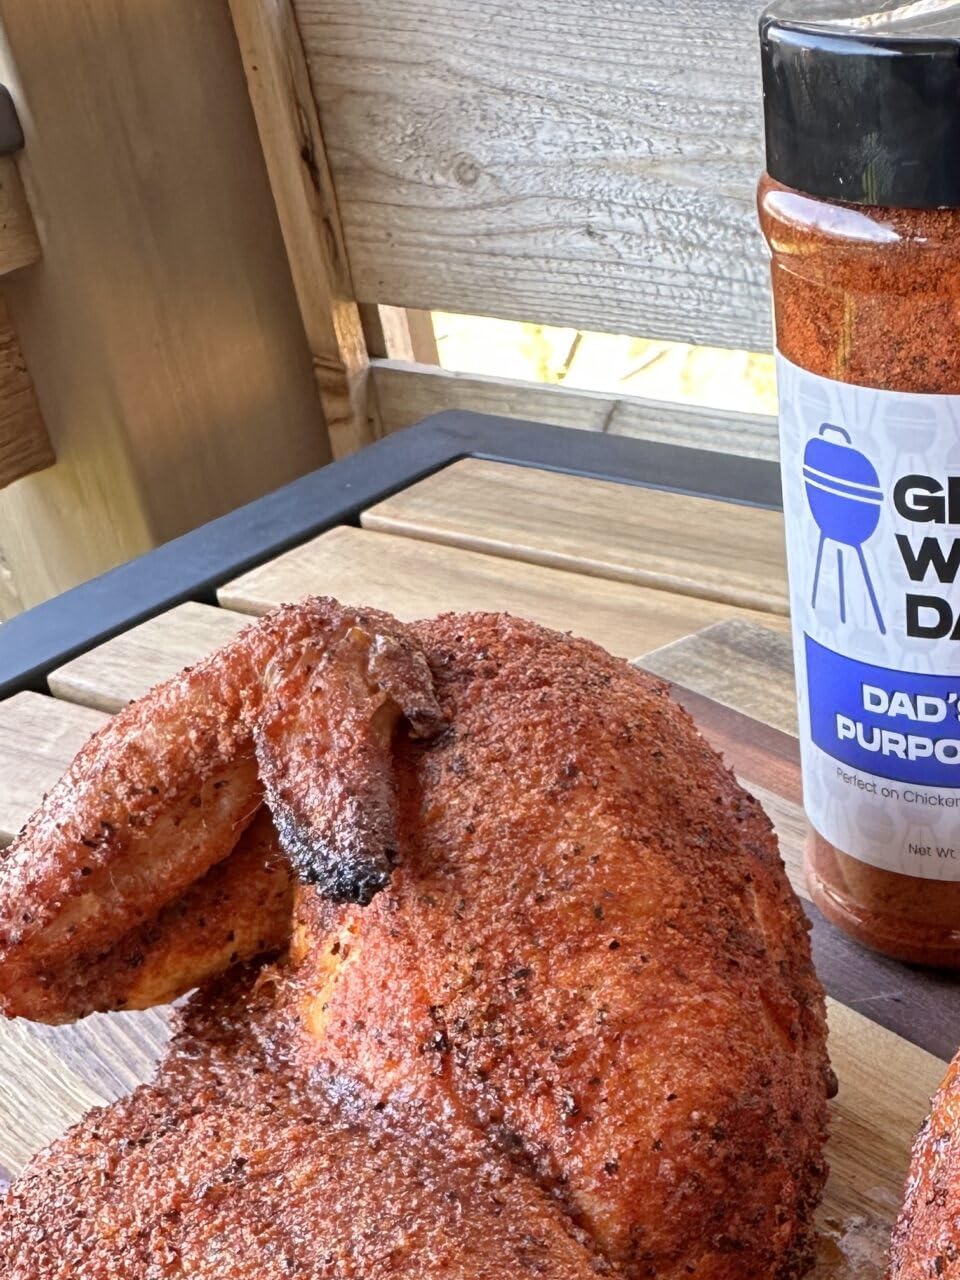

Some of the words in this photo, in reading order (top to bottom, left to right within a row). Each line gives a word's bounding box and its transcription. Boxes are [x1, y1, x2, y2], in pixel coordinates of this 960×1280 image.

[836, 766, 877, 795] Perfect
[881, 786, 899, 800] on
[908, 842, 932, 857] Net
[936, 846, 956, 860] Wt
